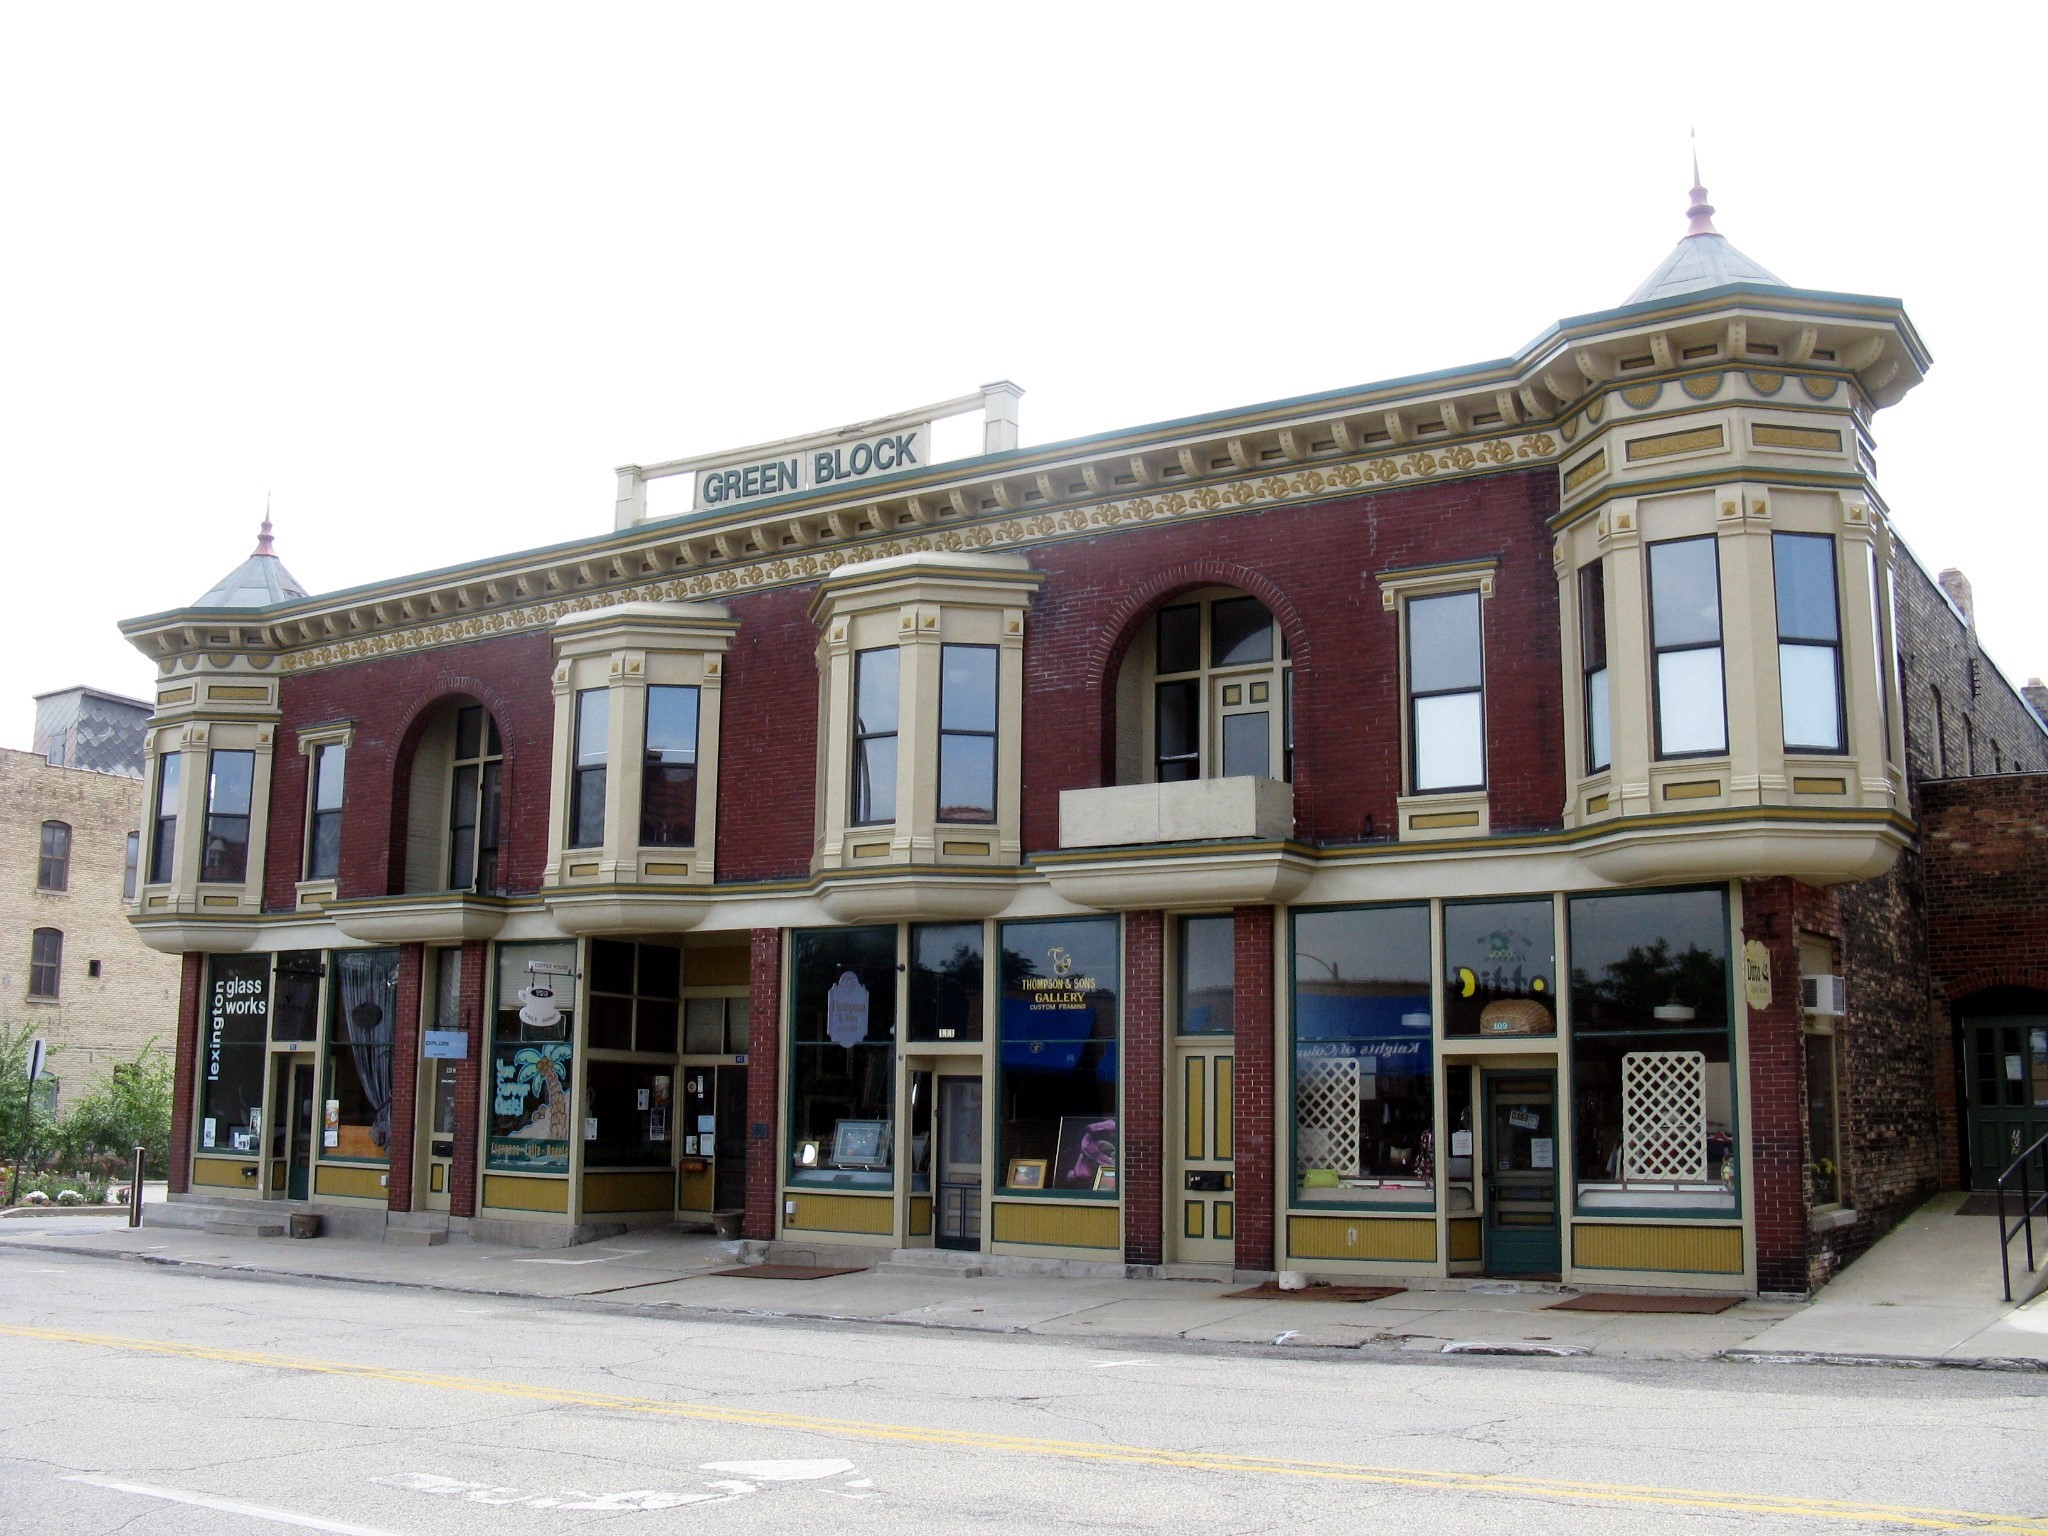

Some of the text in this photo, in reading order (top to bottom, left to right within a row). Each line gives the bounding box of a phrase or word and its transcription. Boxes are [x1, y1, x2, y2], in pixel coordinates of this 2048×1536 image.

[703, 432, 917, 504] GREEN BLOCK
[1747, 958, 1760, 981] Ditto
[226, 976, 262, 998] glass
[1022, 978, 1096, 990] THOMPSON & SONS
[225, 997, 266, 1014] works
[1035, 992, 1086, 1003] GALLERY
[525, 1012, 556, 1024] DAILY GRIND
[1493, 1022, 1508, 1030] 109
[208, 981, 224, 1080] lexington
